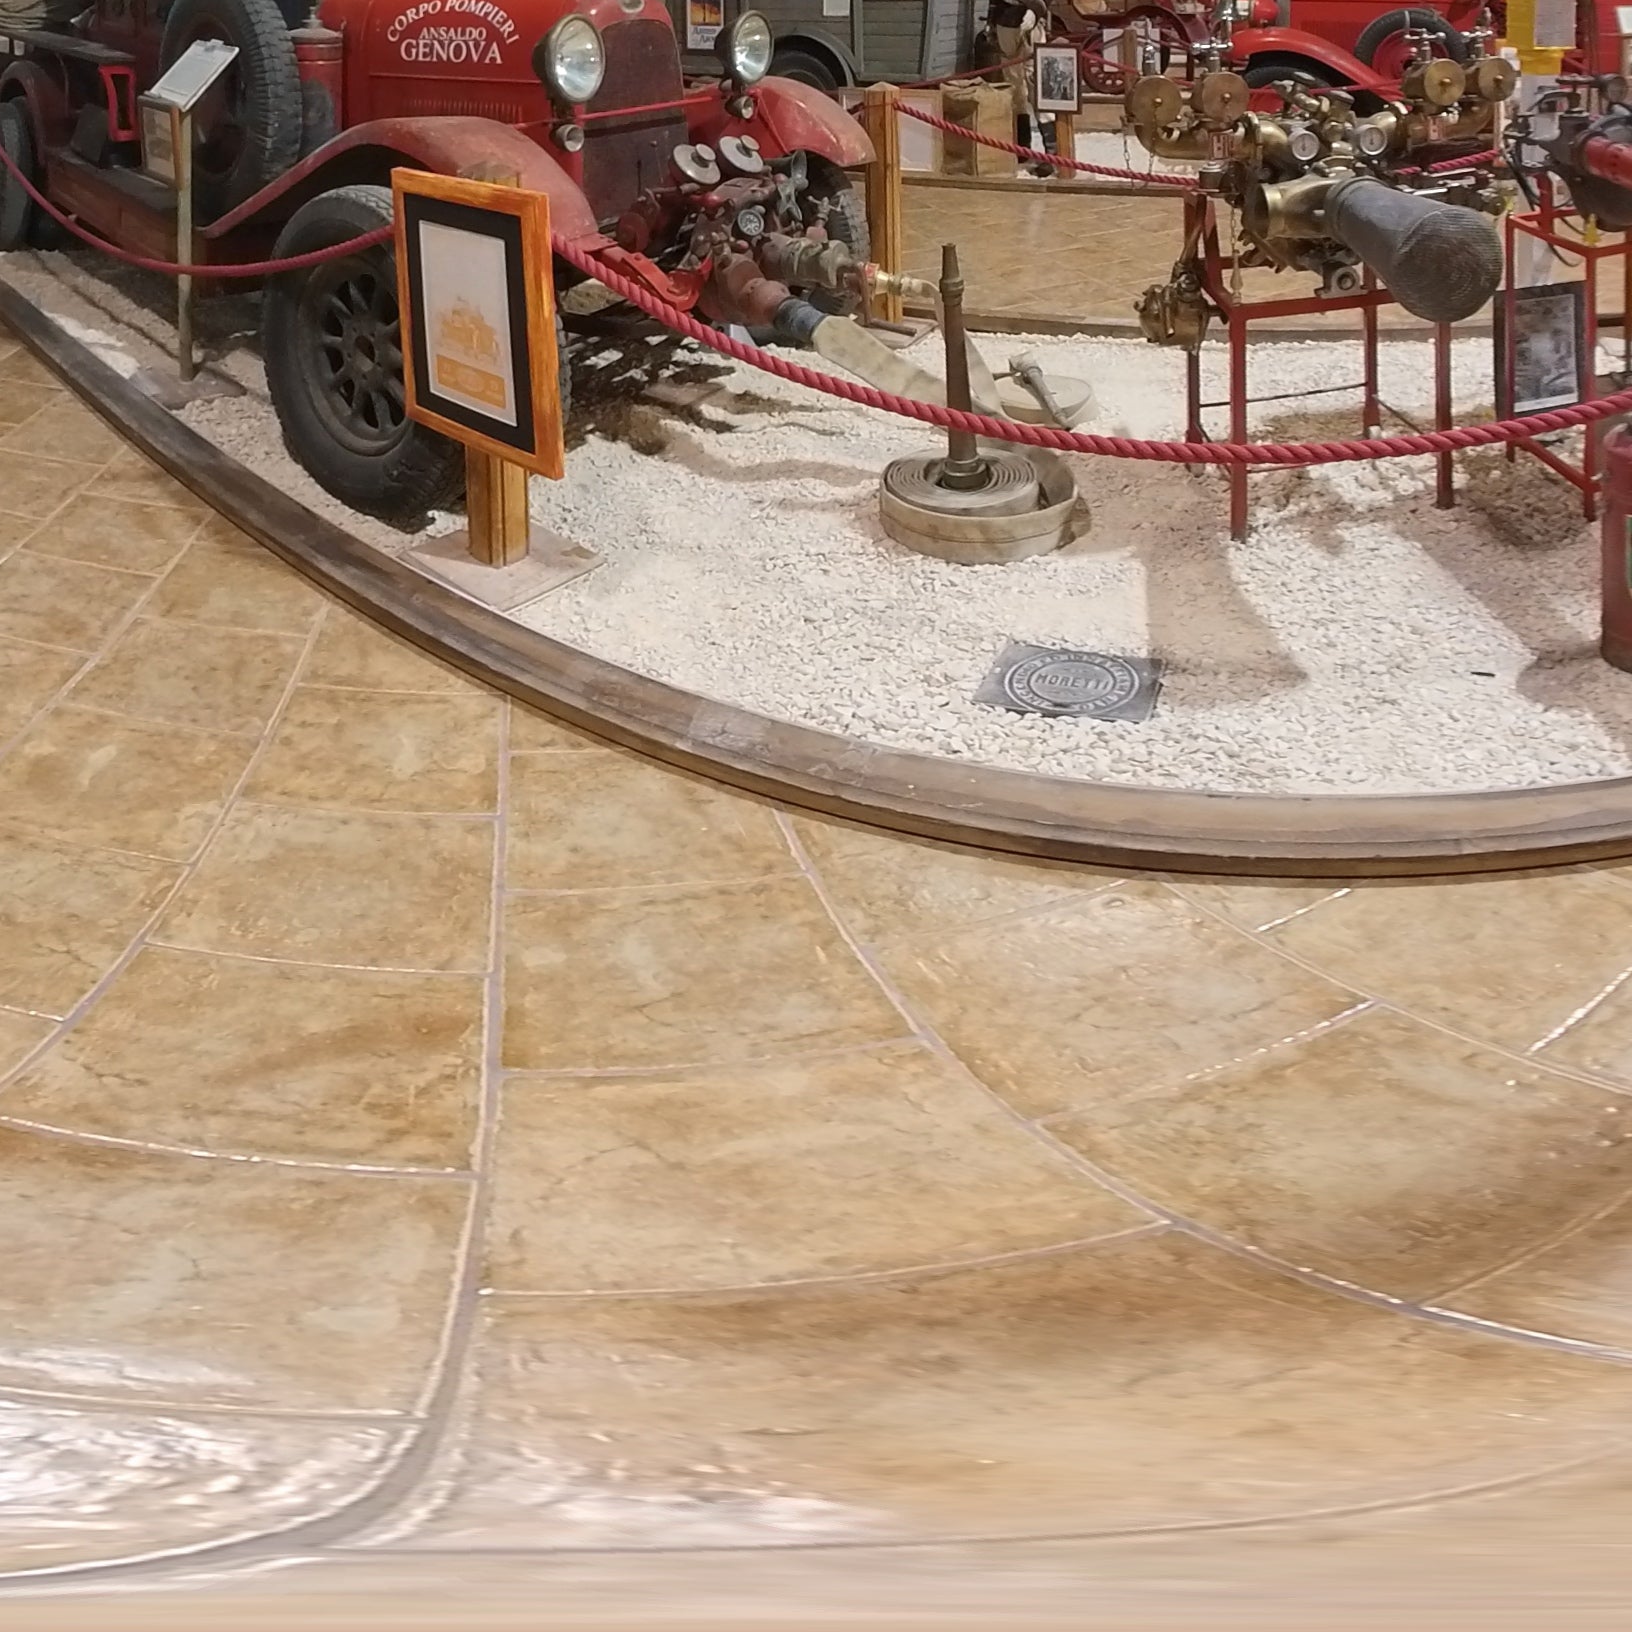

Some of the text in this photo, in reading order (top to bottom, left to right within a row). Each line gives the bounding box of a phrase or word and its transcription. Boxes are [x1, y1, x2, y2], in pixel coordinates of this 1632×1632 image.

[387, 0, 441, 42] CORPO
[418, 26, 486, 41] ANSALDO
[400, 38, 503, 65] GENOVA
[1035, 673, 1110, 691] MORETTI
